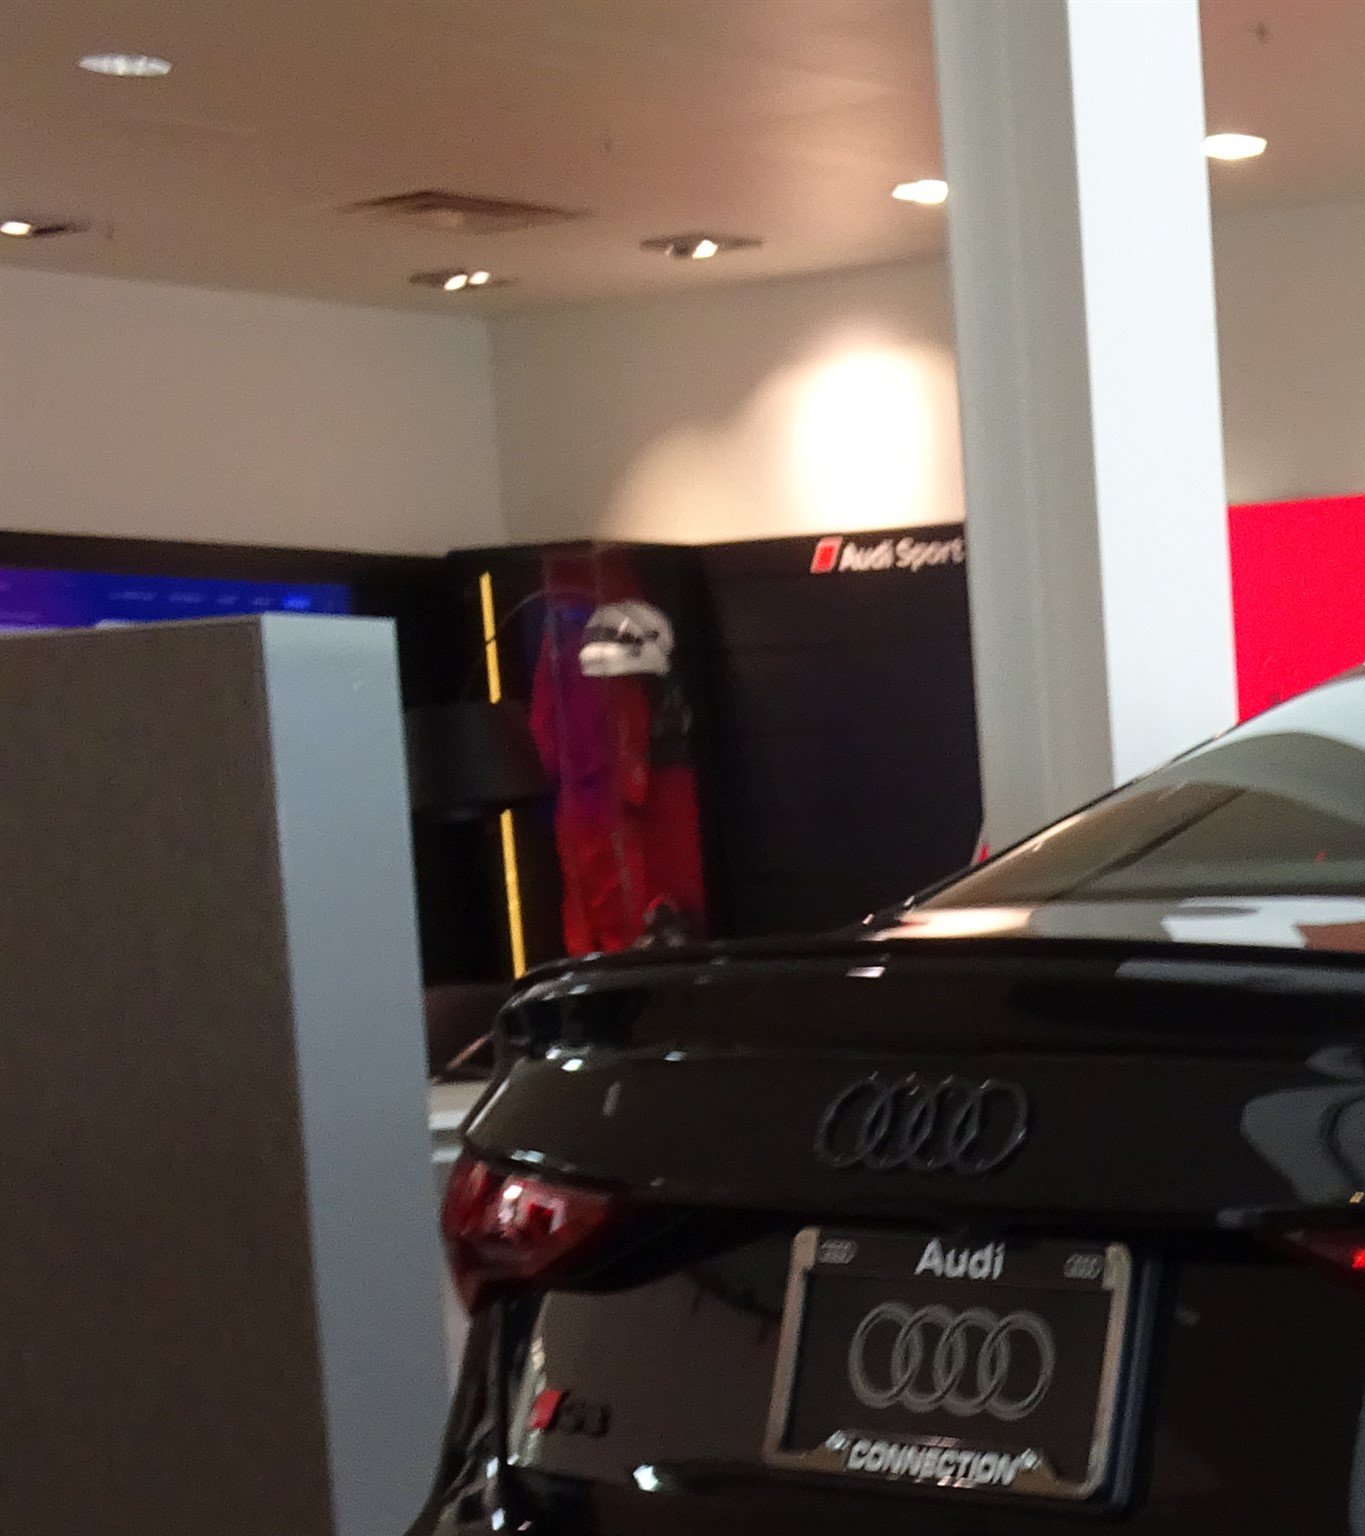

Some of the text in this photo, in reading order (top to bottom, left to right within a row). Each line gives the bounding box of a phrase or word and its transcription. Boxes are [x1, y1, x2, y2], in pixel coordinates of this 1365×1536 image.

[838, 537, 965, 572] Audi Sport
[914, 1237, 1008, 1280] Audi
[847, 1438, 1021, 1487] CONNECTION
